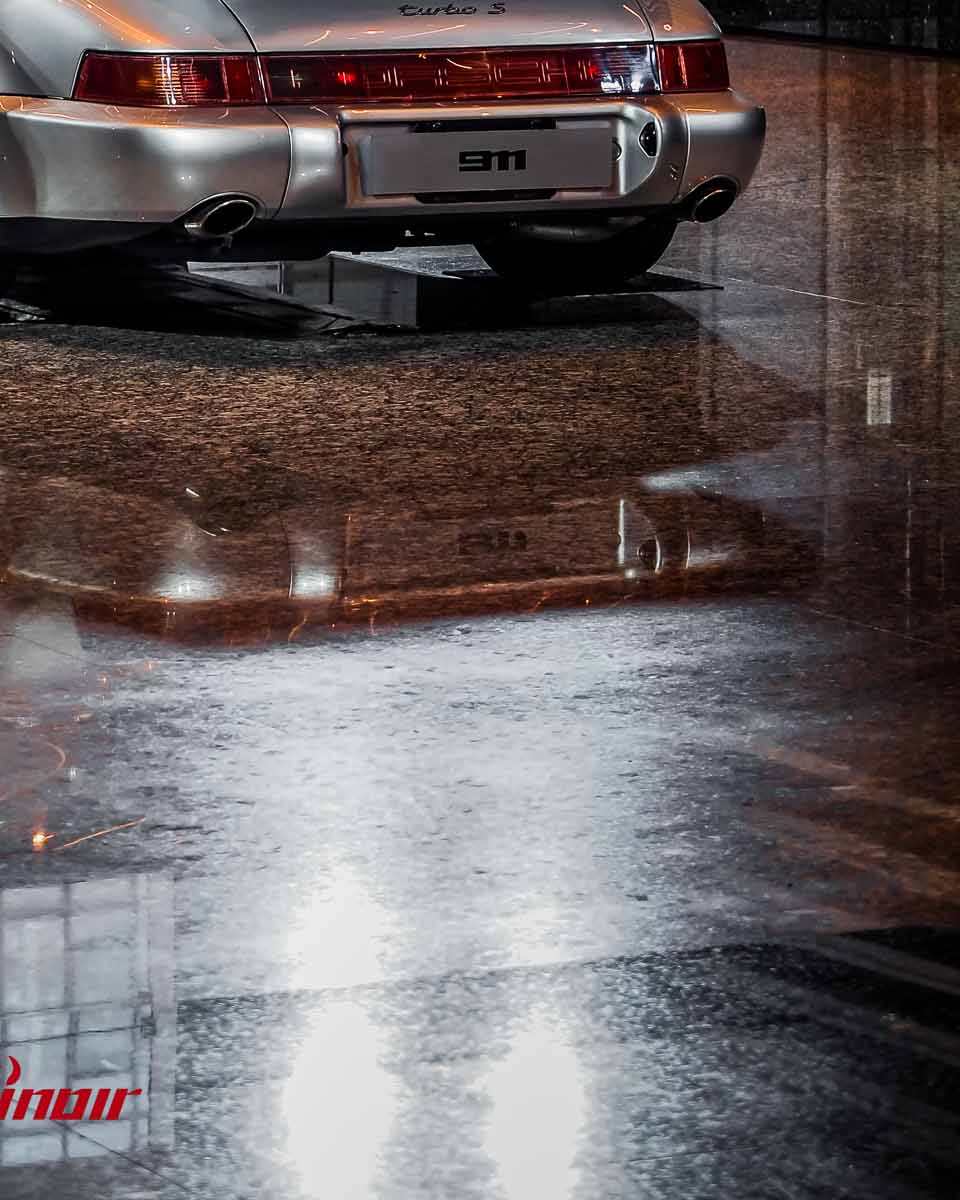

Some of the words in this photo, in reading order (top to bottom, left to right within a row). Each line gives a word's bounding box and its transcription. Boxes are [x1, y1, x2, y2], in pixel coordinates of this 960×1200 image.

[397, 3, 477, 17] turbo
[487, 2, 506, 15] S
[458, 149, 528, 173] 911
